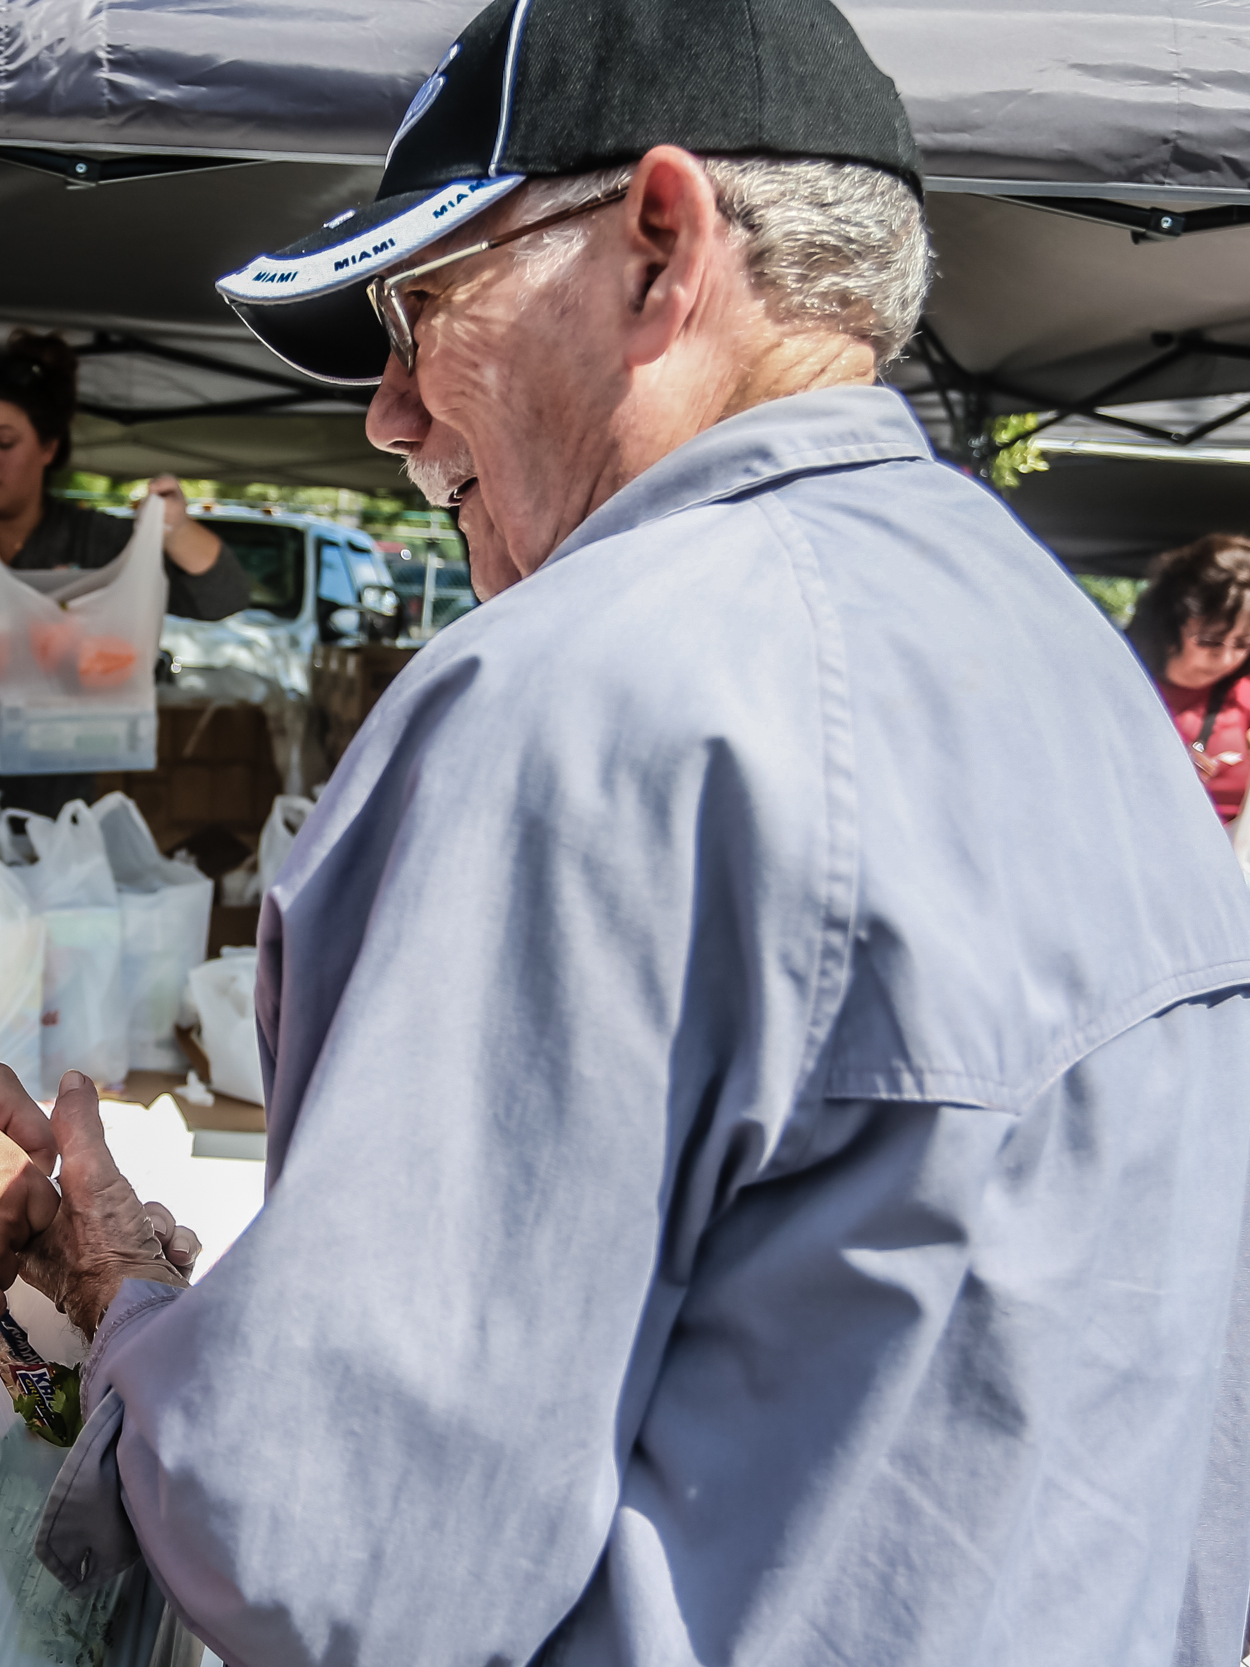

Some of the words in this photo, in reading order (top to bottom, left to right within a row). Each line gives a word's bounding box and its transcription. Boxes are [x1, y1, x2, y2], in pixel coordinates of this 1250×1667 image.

[252, 270, 299, 284] MIAMI
[334, 237, 397, 272] MIAMI
[432, 179, 486, 220] MIAM
